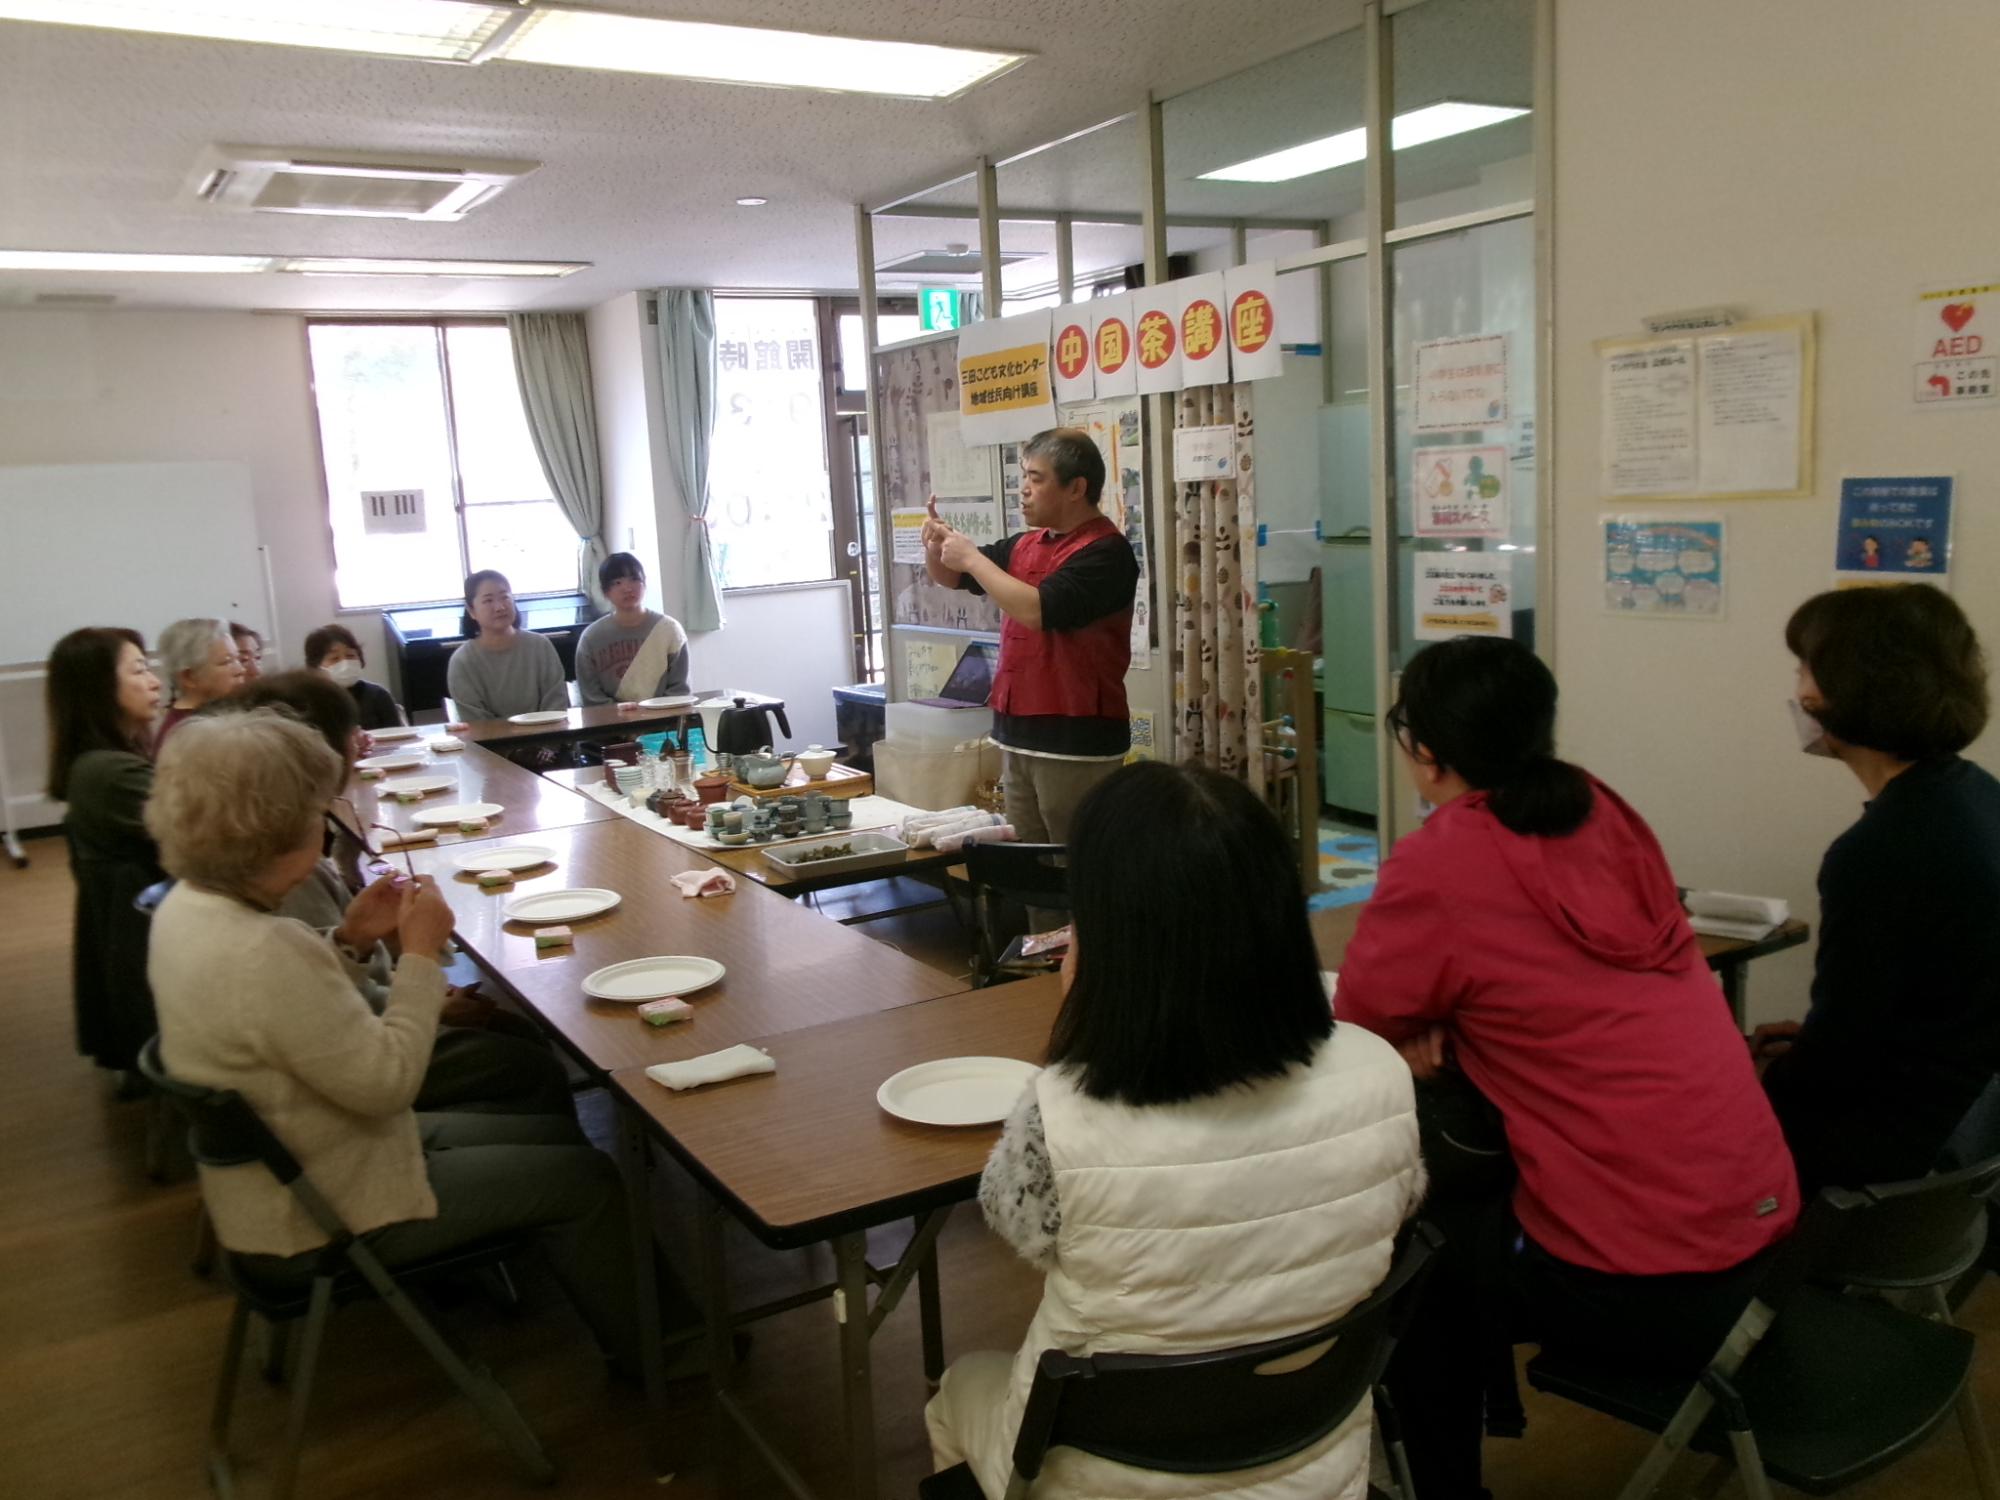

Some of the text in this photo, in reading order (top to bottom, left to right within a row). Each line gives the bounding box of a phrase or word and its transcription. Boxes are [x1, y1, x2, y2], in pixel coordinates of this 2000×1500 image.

[1060, 296, 1266, 372] 中国茶講座
[1932, 335, 1983, 358] AED
[971, 382, 1039, 405] 地域住民向け講座
